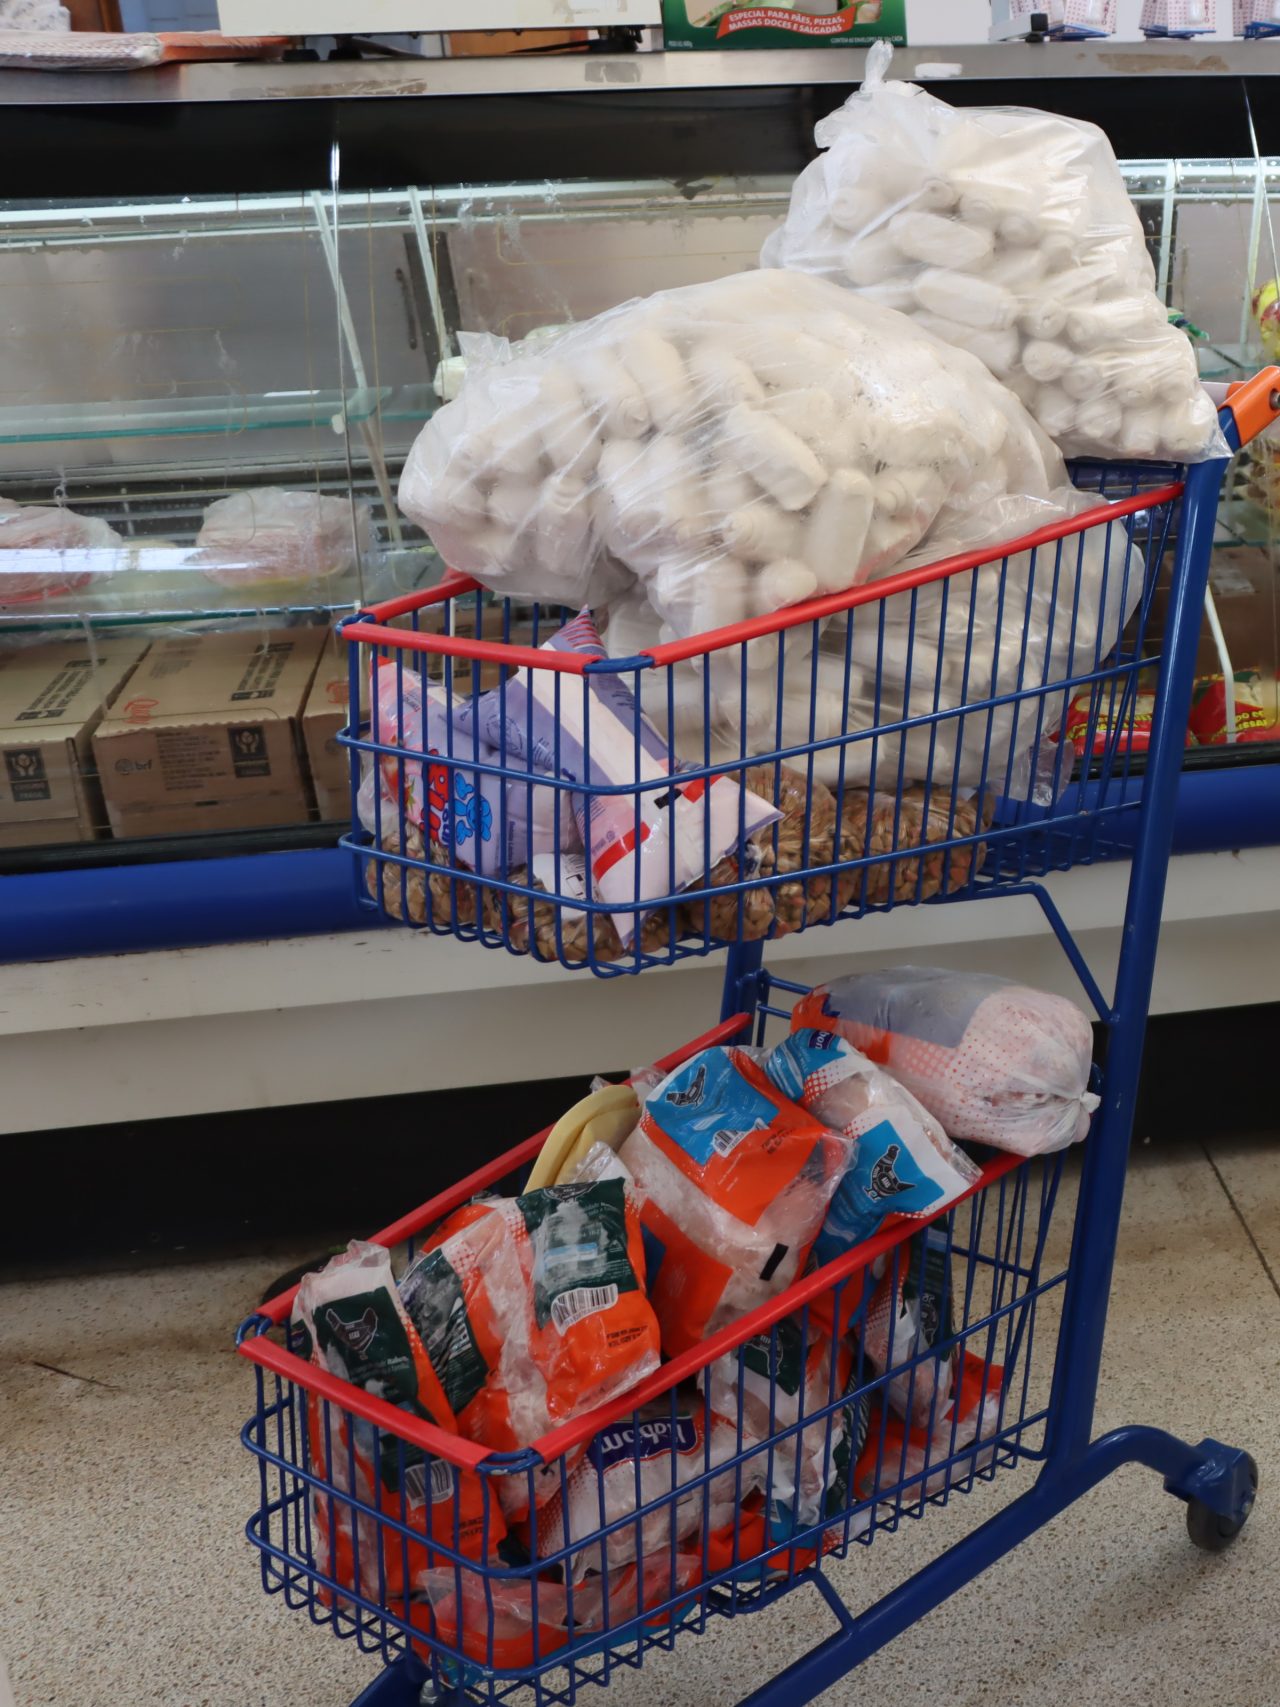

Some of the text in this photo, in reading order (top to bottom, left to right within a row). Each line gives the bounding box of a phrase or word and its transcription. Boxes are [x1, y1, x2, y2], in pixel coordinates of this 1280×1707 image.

[729, 10, 766, 21] ESPECIAL
[767, 10, 790, 20] PARA
[790, 12, 812, 26] PÃES,
[729, 19, 762, 31] MASSAS
[764, 18, 791, 29] DOCES
[799, 24, 842, 33] SALGADAS
[135, 759, 152, 770] brf
[602, 1422, 685, 1454] Iabom
